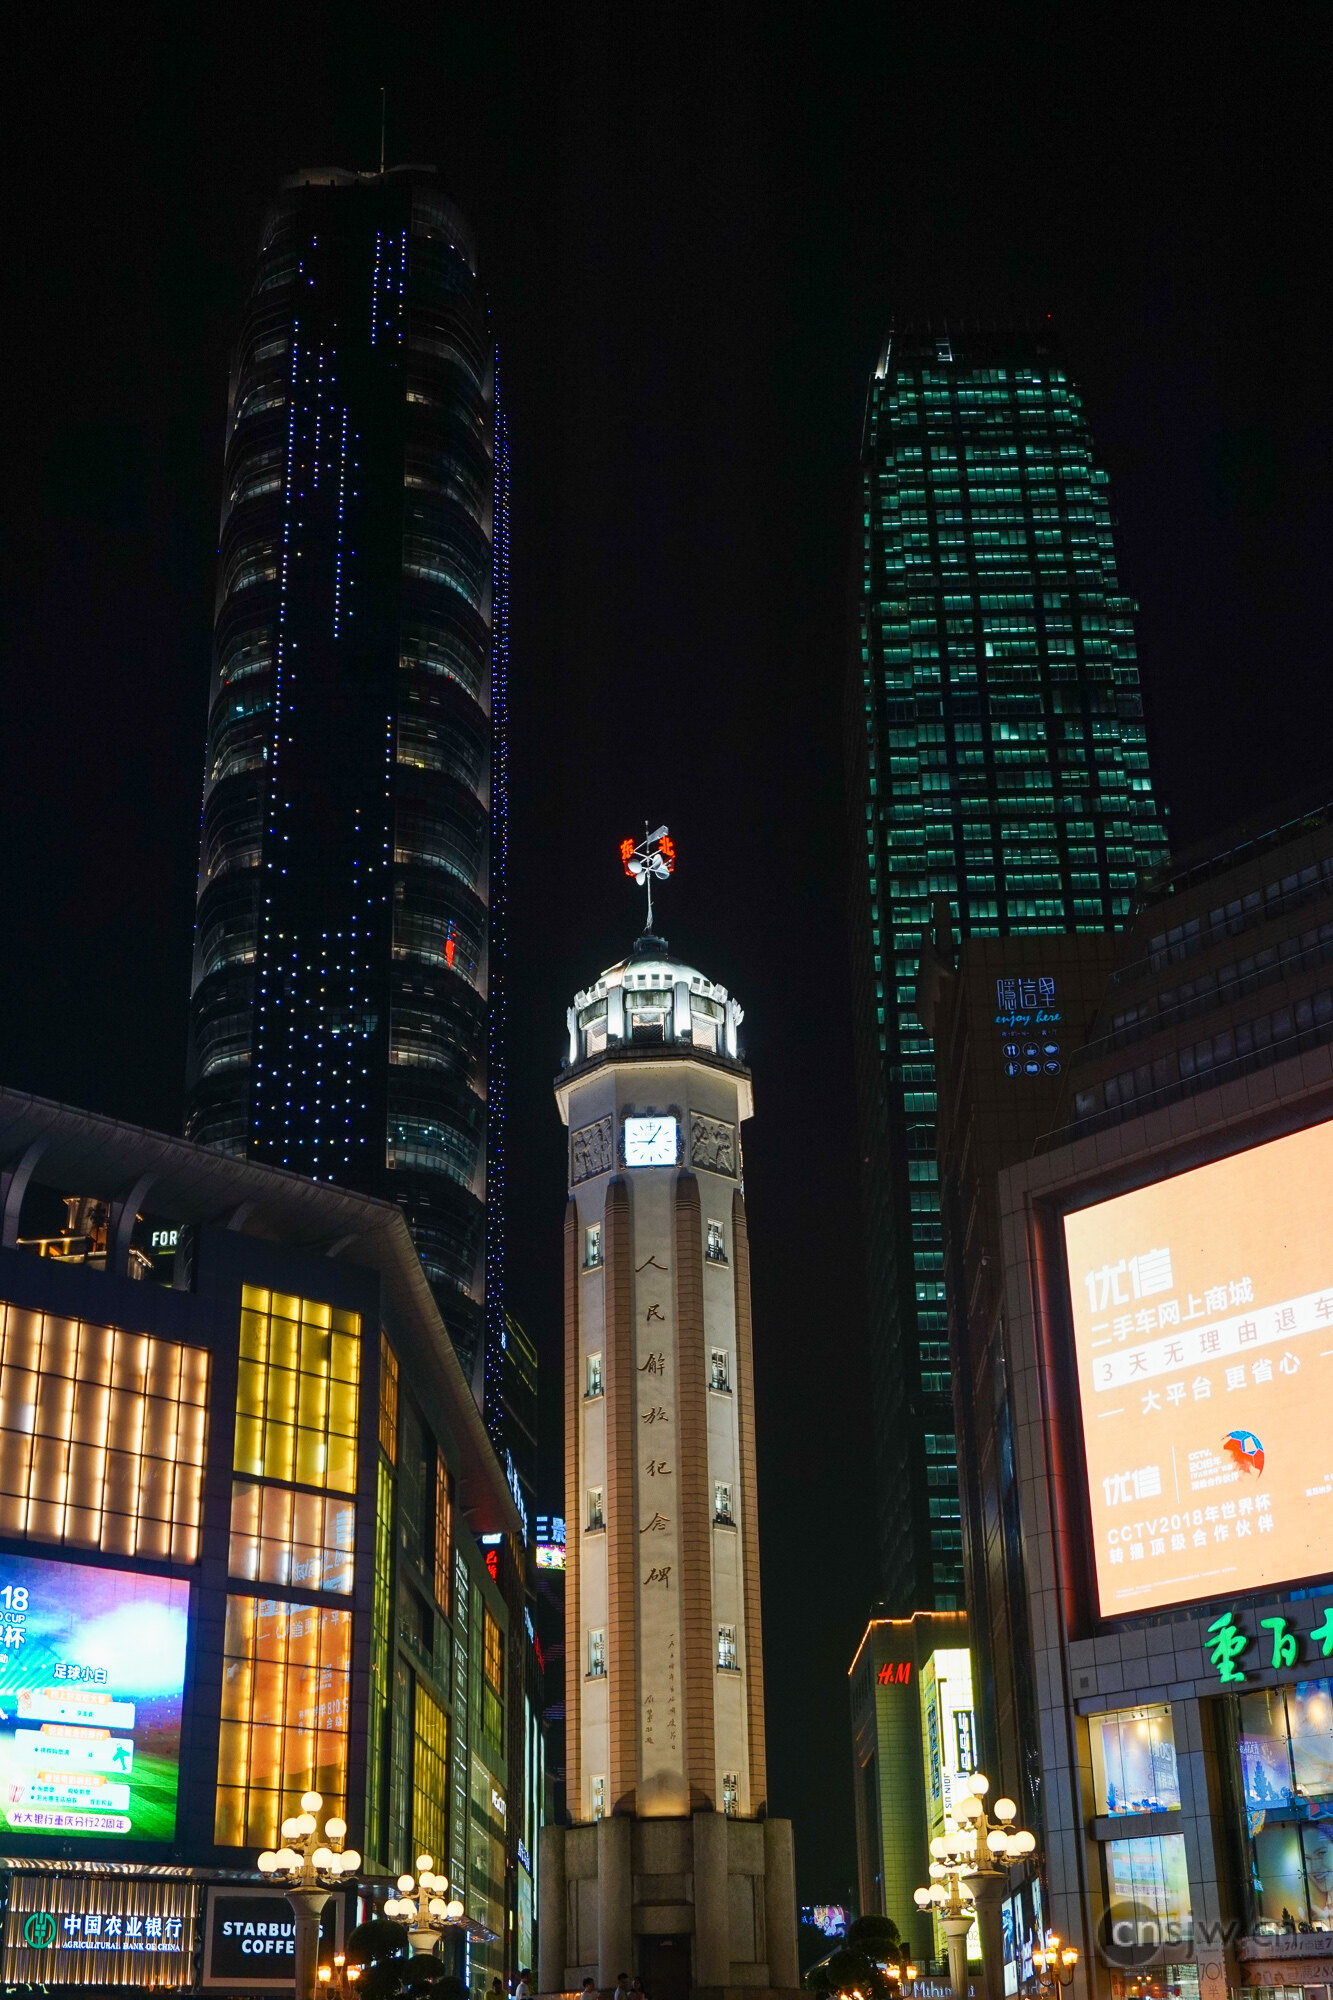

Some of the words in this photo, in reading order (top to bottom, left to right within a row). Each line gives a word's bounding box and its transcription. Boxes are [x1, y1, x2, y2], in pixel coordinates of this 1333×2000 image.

[620, 838, 635, 860] 东
[658, 836, 675, 857] 北
[995, 1011, 1031, 1028] enjoy
[1036, 1010, 1062, 1023] here
[1085, 1247, 1173, 1313] 优信
[1091, 1276, 1254, 1348] 二手车网上商城
[1102, 1297, 1333, 1381] 3天无理由退车
[1141, 1376, 1212, 1414] 大平台
[1225, 1352, 1300, 1391] 更省心
[1102, 1465, 1162, 1507] 优信
[1107, 1493, 1272, 1545] CCTV2018年世界杯
[1109, 1514, 1275, 1565] 转播顶级合作伙伴
[53, 1664, 107, 1684] 足球小白
[878, 1662, 911, 1685] H&M
[943, 1773, 952, 1794] JOIN
[945, 1797, 952, 1809] US
[13, 1812, 125, 1831] 光大银行重庆分行22周年
[63, 1914, 182, 1938] 中国农业银行
[62, 1941, 120, 1950] AGRICULTURAL
[123, 1942, 144, 1950] BANK
[145, 1943, 156, 1951] OF
[157, 1943, 181, 1951] CHINA
[241, 1939, 295, 1954] COFFE
